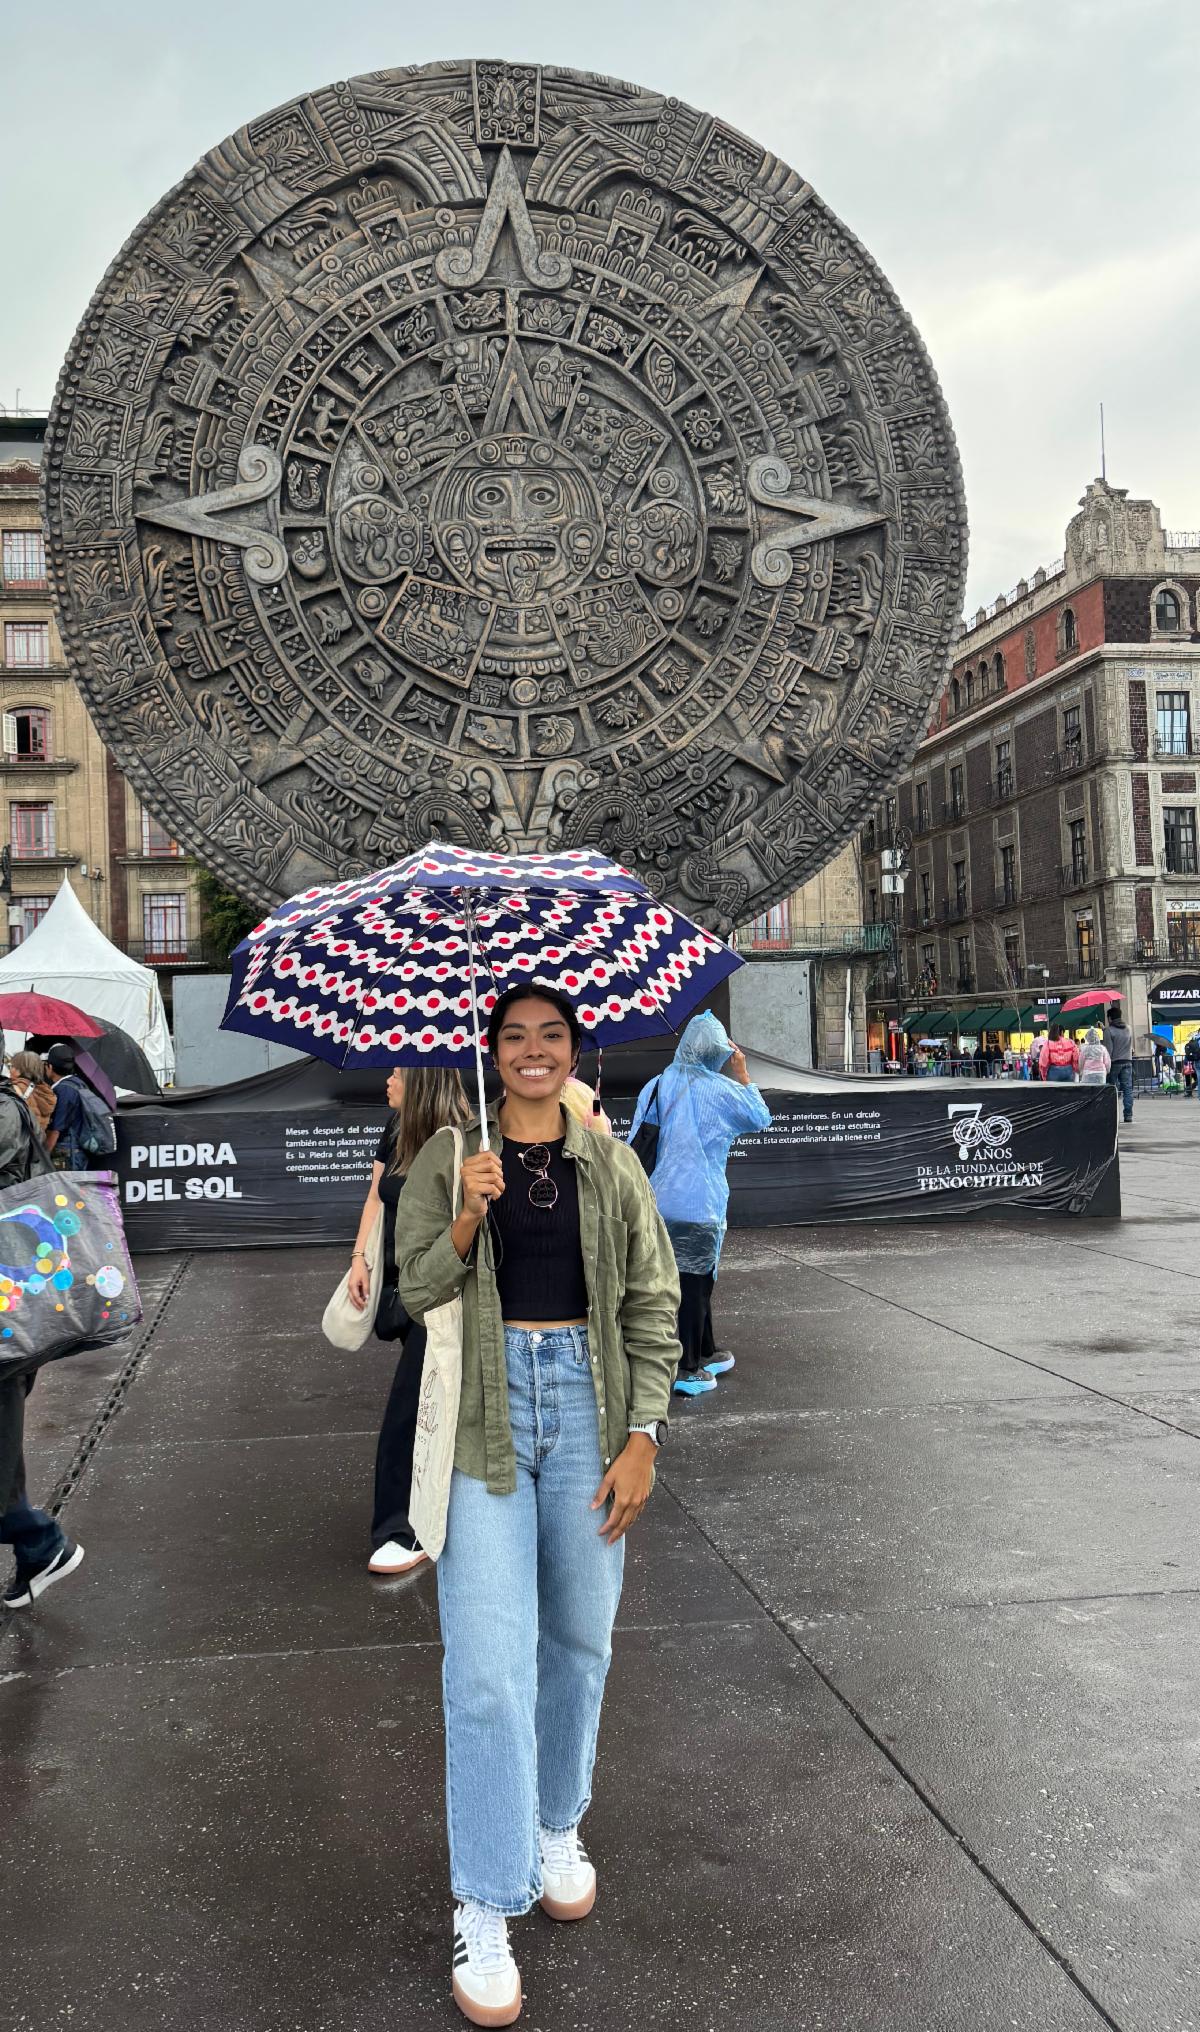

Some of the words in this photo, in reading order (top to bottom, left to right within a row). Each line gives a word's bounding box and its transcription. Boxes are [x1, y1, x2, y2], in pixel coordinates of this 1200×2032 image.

[620, 1117, 631, 1125] los
[792, 1112, 829, 1121] anteriores.
[831, 1111, 841, 1120] En
[285, 1127, 309, 1136] Meses
[313, 1126, 344, 1136] después
[347, 1125, 360, 1134] del
[363, 1125, 385, 1133] descu
[791, 1124, 804, 1133] por
[815, 1124, 829, 1132] que
[831, 1123, 846, 1131] esta
[847, 1122, 880, 1130] escultura
[285, 1139, 317, 1148] también
[318, 1139, 328, 1147] en
[328, 1138, 336, 1146] la
[336, 1138, 357, 1148] plaza
[357, 1138, 380, 1146] mayor
[736, 1137, 763, 1145] Azteca.
[763, 1136, 778, 1144] Esta
[778, 1135, 828, 1144] extraordinaria
[844, 1133, 863, 1141] tiene
[873, 1132, 881, 1140] el
[130, 1142, 237, 1169] PIEDRA
[285, 1151, 295, 1160] Es
[298, 1151, 306, 1159] la
[309, 1150, 333, 1158] Piedra
[336, 1149, 349, 1157] del
[352, 1149, 366, 1157] Sol.
[973, 1146, 1012, 1160] AÑOS
[285, 1163, 329, 1172] ceremonias
[329, 1161, 340, 1170] de
[340, 1160, 373, 1169] sacrificio
[917, 1166, 933, 1176] DE
[936, 1164, 951, 1175] LA
[954, 1161, 1026, 1174] FUNDACIÓN
[1028, 1161, 1044, 1172] DE
[297, 1174, 318, 1183] Tiene
[319, 1174, 330, 1182] en
[340, 1173, 364, 1181] centro
[917, 1173, 1044, 1191] TENOCHTITLAN
[125, 1179, 181, 1204] DEL
[184, 1176, 243, 1200] SOL
